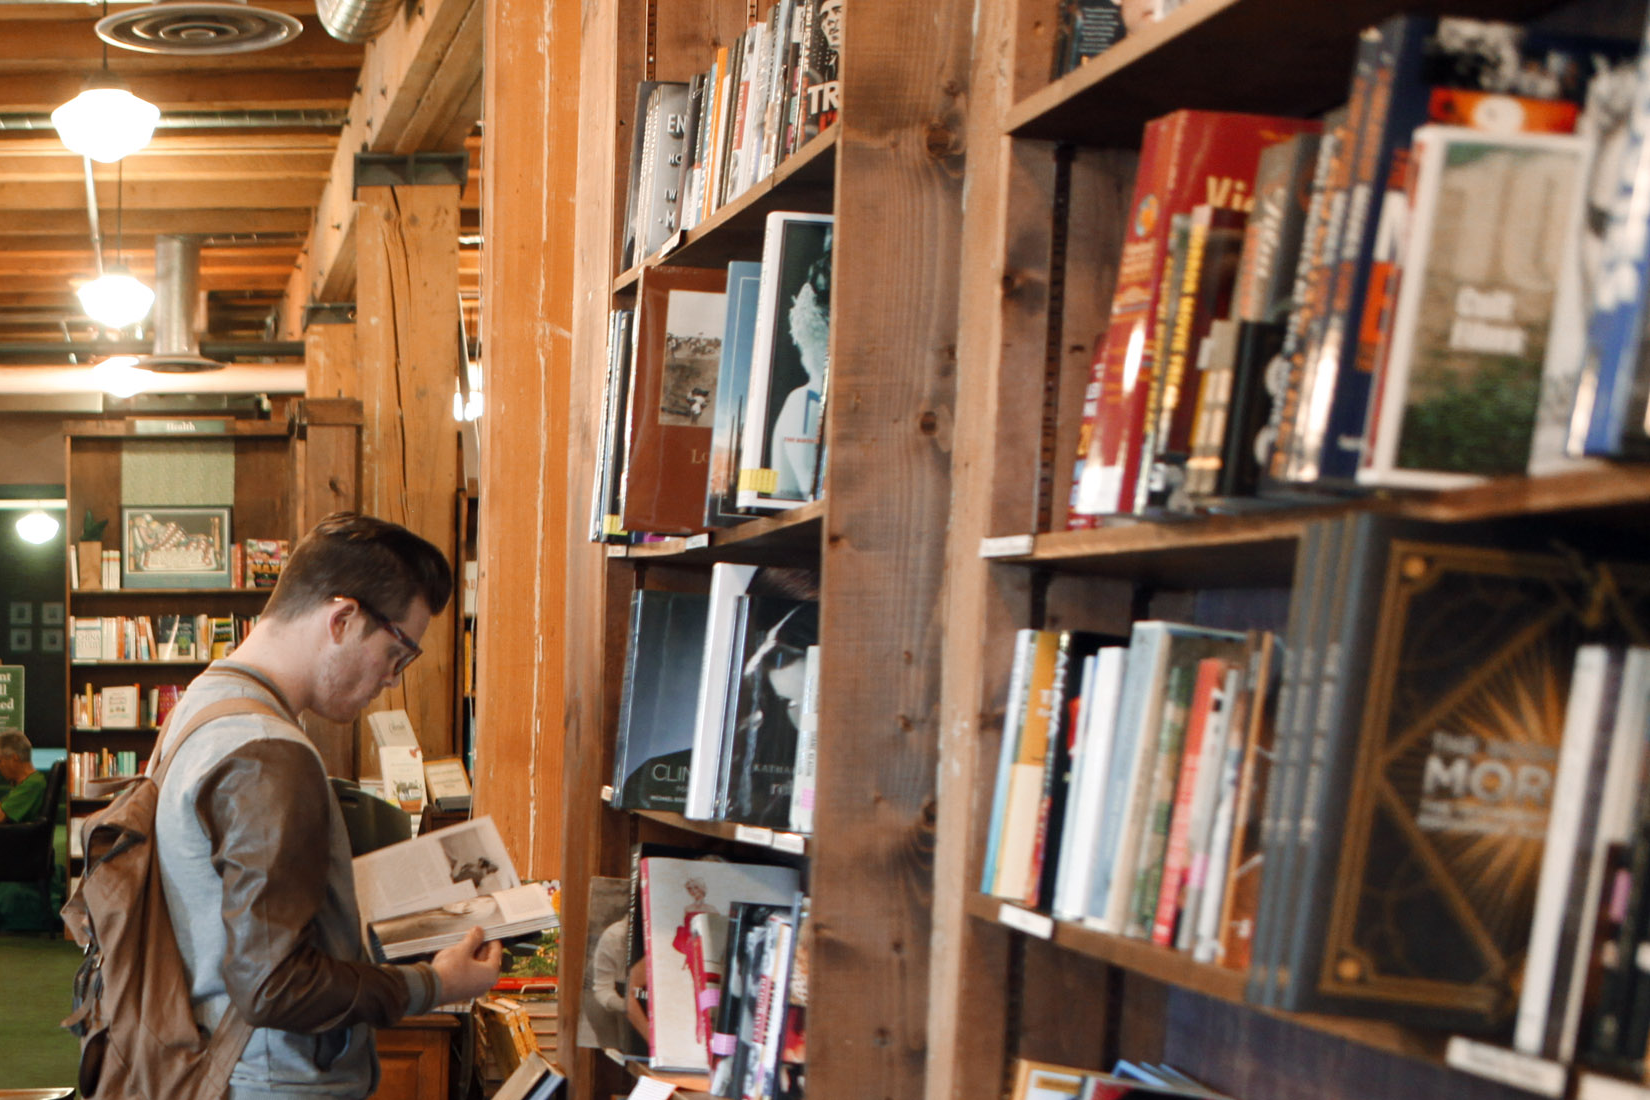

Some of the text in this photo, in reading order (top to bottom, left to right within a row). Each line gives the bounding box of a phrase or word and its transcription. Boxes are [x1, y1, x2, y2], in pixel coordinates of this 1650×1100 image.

[166, 420, 196, 431] Health
[652, 764, 691, 782] CLIN
[754, 765, 794, 773] KATHA
[1423, 754, 1552, 805] MOR
